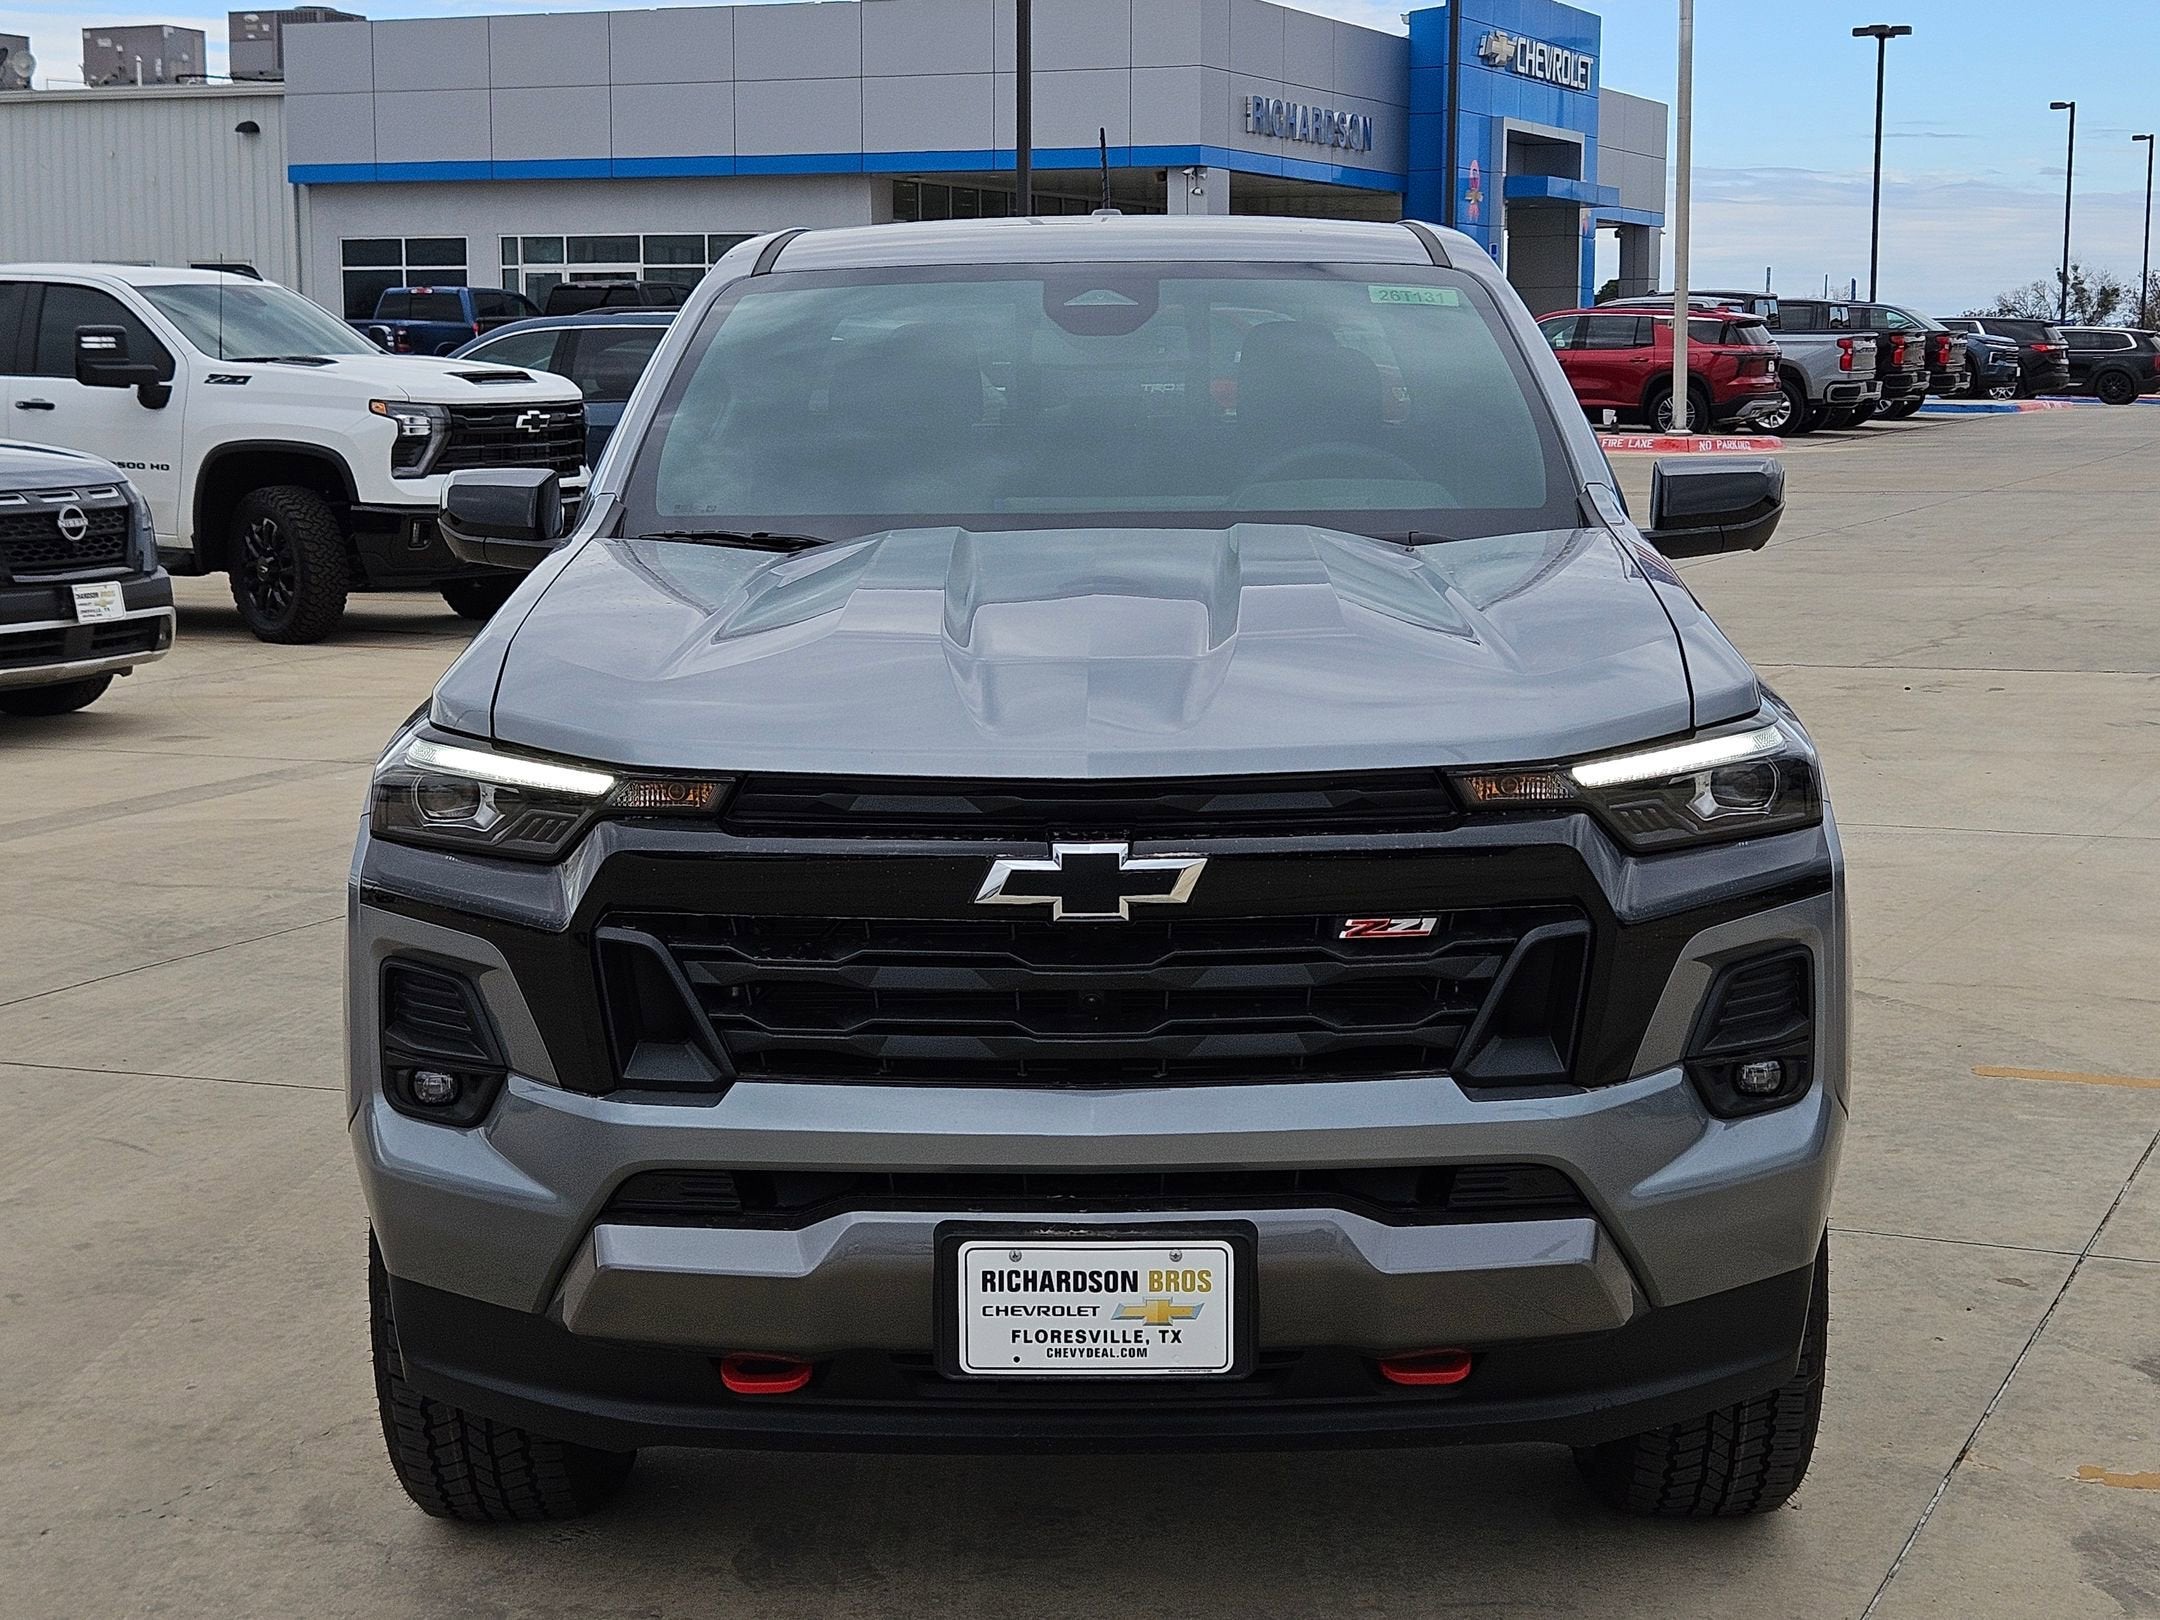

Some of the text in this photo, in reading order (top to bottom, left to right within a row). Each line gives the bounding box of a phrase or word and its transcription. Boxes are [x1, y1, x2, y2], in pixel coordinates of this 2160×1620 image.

[1516, 37, 1594, 90] CHEVROLET
[1246, 96, 1372, 151] RICHARDSON
[1379, 289, 1444, 304] 26T131
[1601, 438, 1653, 448] FIRE LANE
[1699, 439, 1751, 451] NO PARKING
[150, 462, 170, 471] HD
[1339, 918, 1437, 939] Z71
[981, 1269, 1212, 1293] RICHARDSON BROS
[982, 1305, 1100, 1317] CHEVROLET
[1011, 1329, 1182, 1346] FLORESVILLE, TX
[1046, 1347, 1148, 1358] CHEVYDEAL.COM
